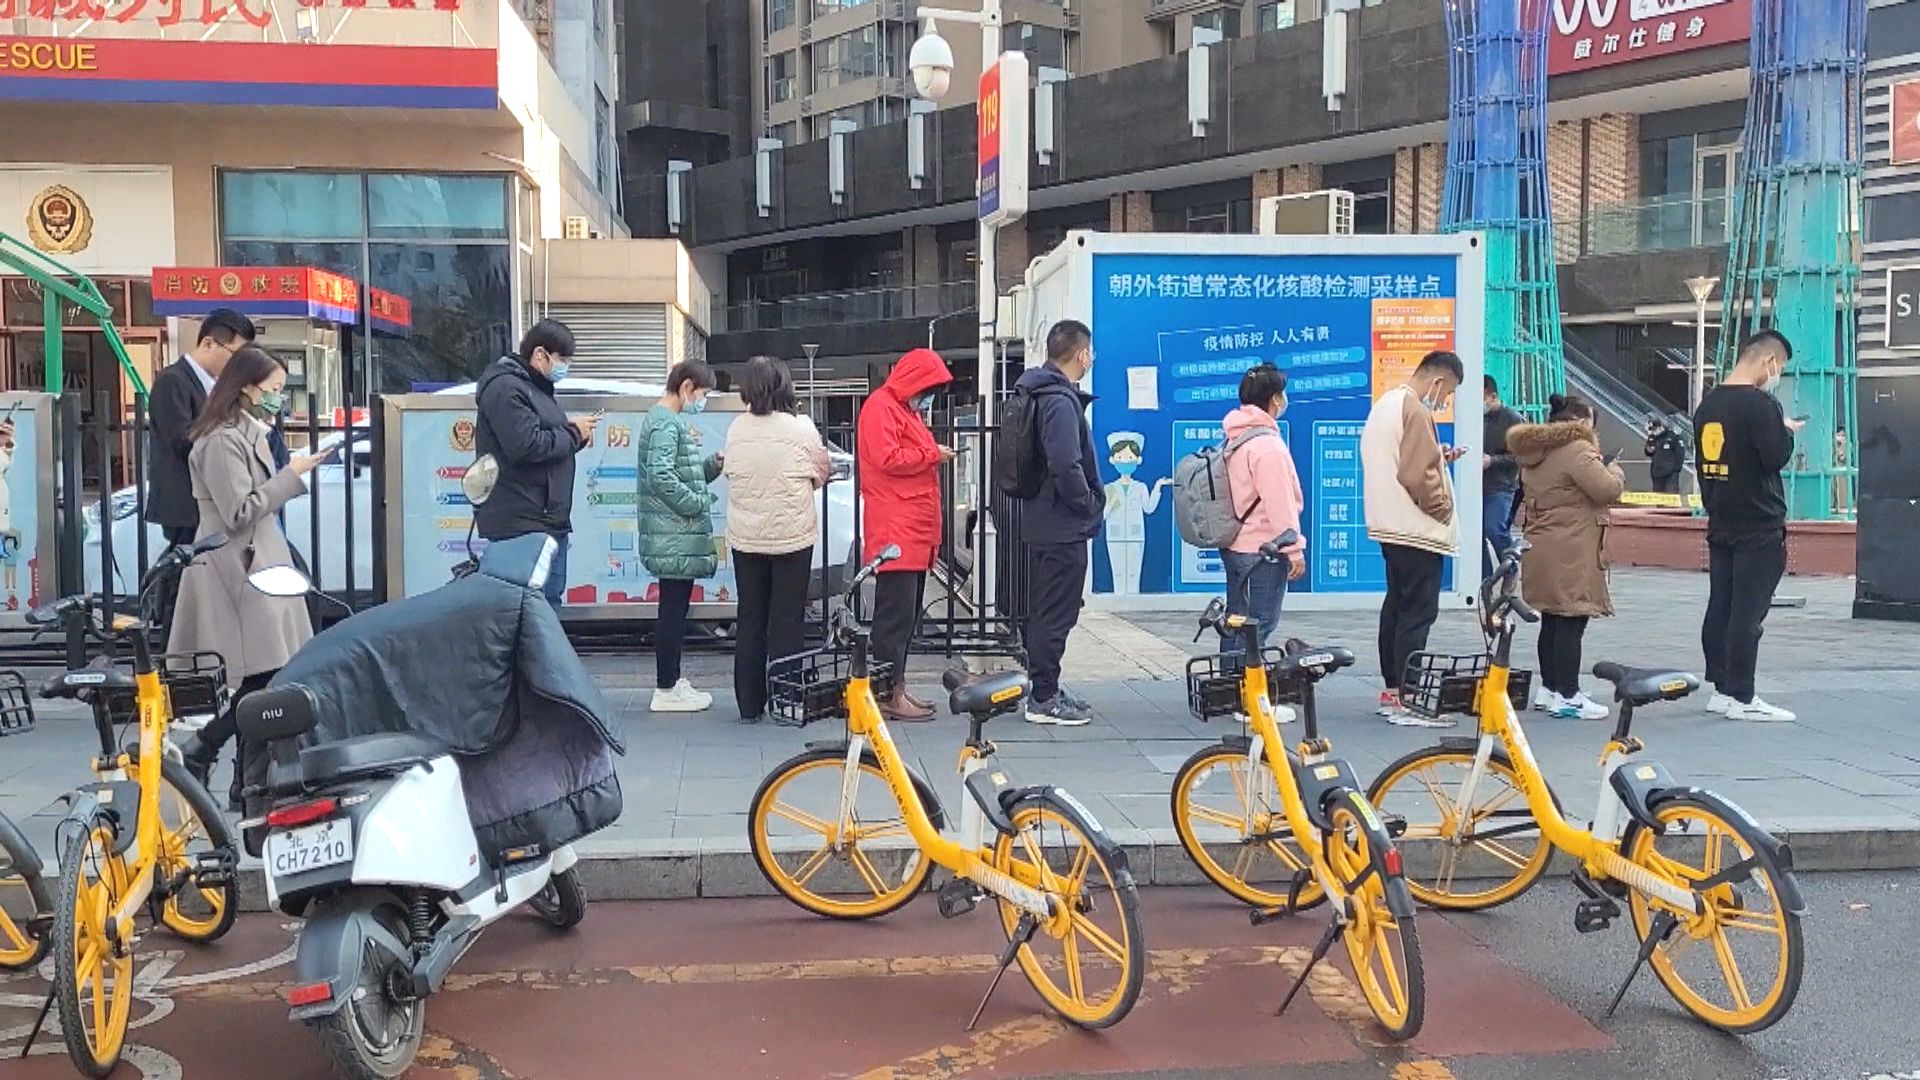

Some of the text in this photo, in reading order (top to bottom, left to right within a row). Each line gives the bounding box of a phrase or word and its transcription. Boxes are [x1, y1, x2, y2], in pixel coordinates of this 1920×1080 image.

[1573, 16, 1706, 60] 威尔仕健身
[982, 89, 998, 139] 119
[1109, 274, 1441, 298] 朝外街道常态化核酸检测采样点
[1203, 331, 1265, 351] 疫情防控
[276, 840, 345, 872] CH7210
